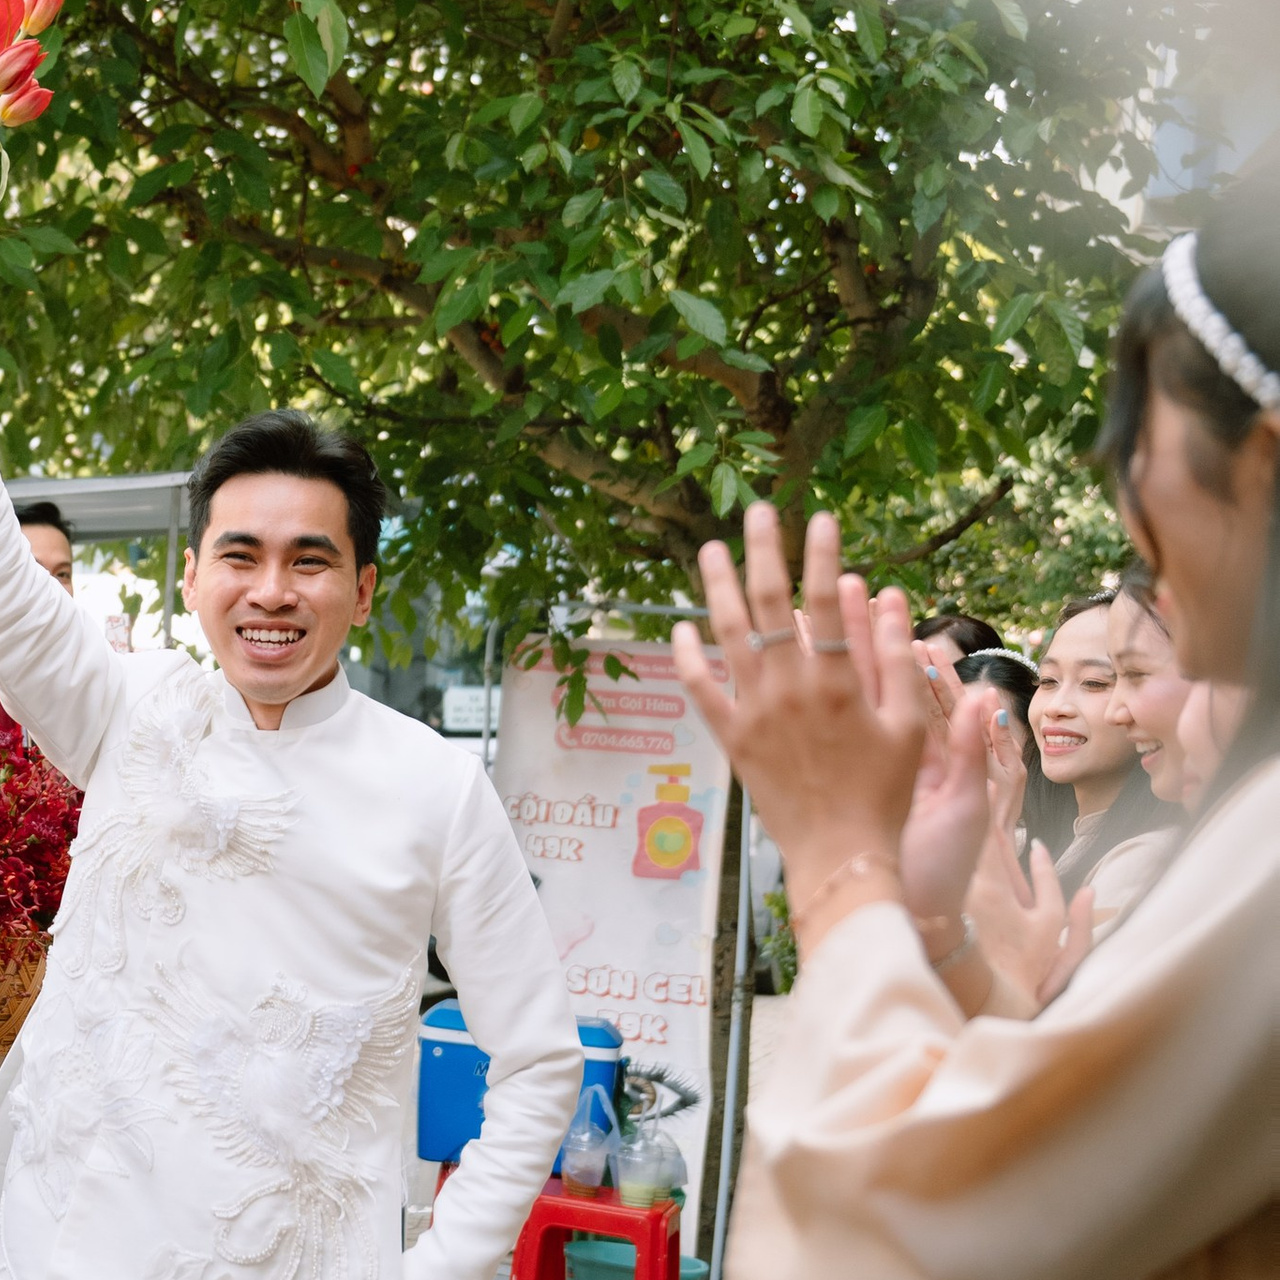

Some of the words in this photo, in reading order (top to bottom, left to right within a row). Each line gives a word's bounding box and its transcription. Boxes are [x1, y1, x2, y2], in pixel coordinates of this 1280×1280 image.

[619, 695, 642, 711] Gội
[525, 833, 585, 862] 49K
[566, 964, 637, 1001] SƠN
[643, 972, 708, 1006] GEL
